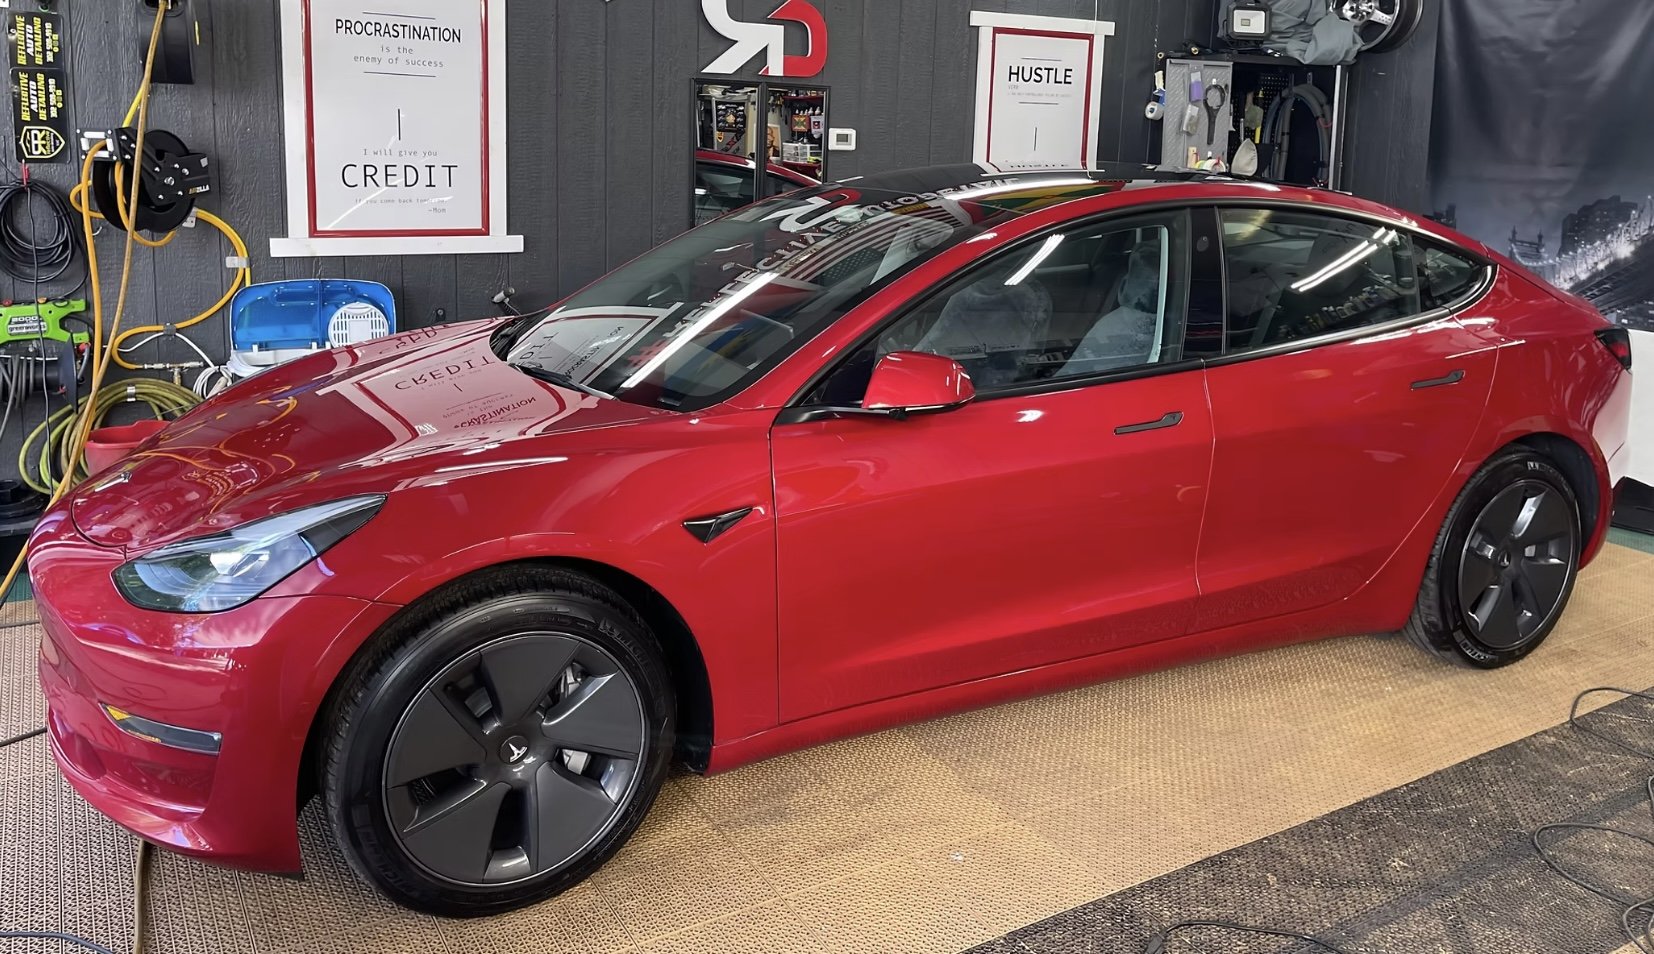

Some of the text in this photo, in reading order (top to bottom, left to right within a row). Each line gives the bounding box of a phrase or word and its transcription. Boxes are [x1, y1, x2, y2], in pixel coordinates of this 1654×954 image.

[16, 15, 26, 65] REFLECTIVE
[26, 24, 34, 56] AUTO
[33, 16, 43, 65] DETAILING
[335, 18, 461, 43] PROCRASTINATION
[354, 55, 444, 68] enemy of success
[381, 44, 413, 54] is the
[1008, 65, 1073, 85] HUSTLE
[19, 72, 31, 121] REFLECTIVE
[29, 80, 38, 112] AUTO
[36, 73, 47, 120] DETAILING
[363, 148, 368, 156] I
[399, 149, 418, 157] give
[341, 163, 459, 188] CREDIT
[8, 324, 47, 332] greenwors
